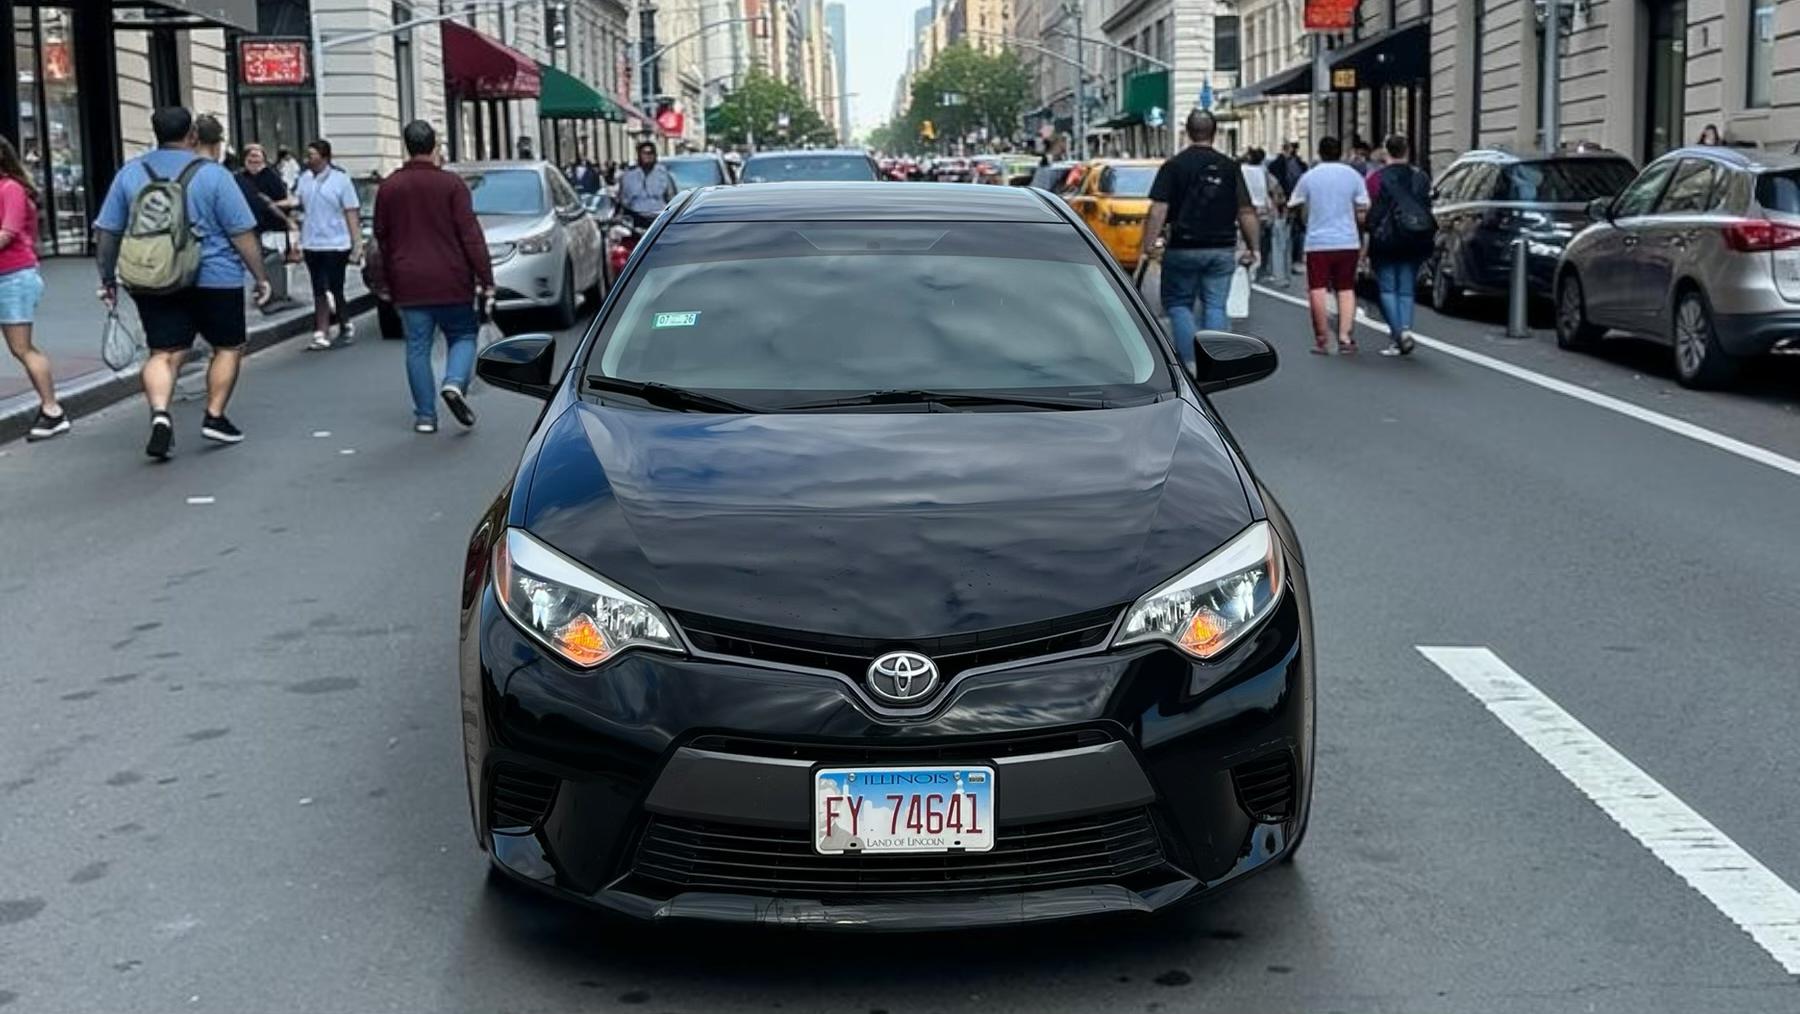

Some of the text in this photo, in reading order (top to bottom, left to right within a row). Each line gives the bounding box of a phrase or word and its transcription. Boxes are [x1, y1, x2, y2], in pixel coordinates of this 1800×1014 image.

[864, 773, 949, 786] ILLINOIS
[826, 793, 983, 836] FY 74641
